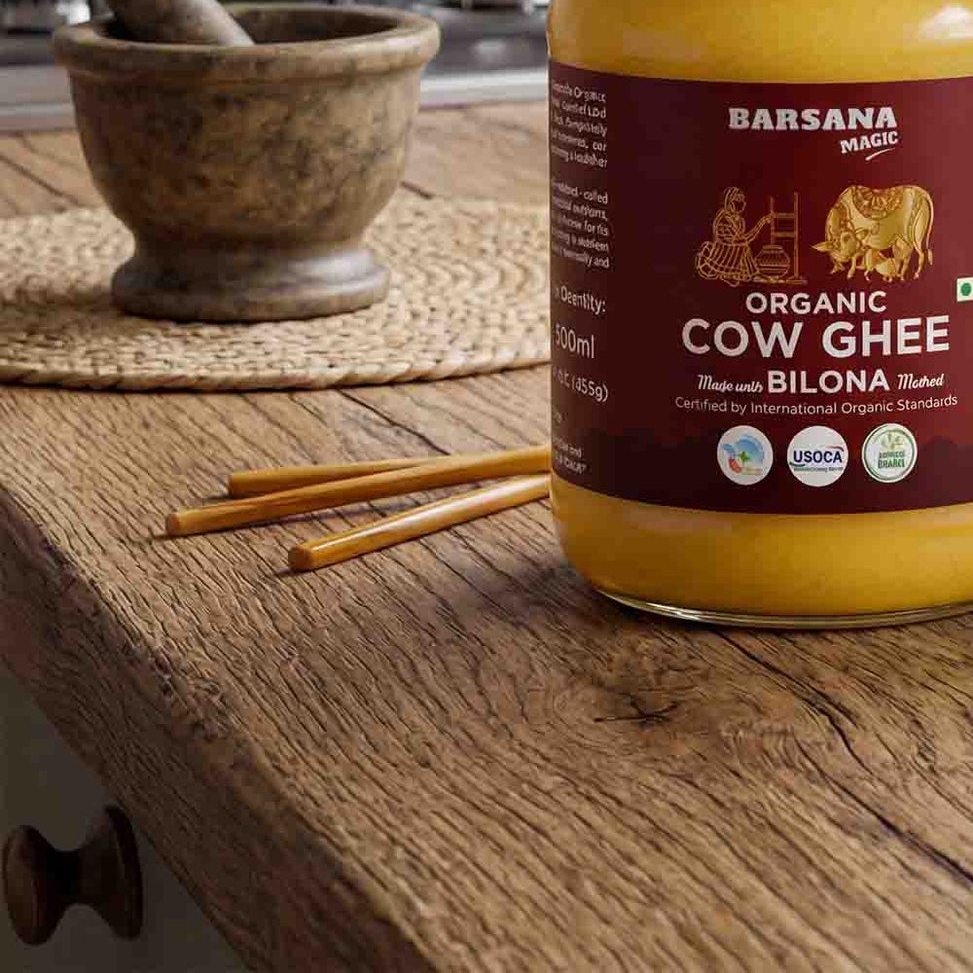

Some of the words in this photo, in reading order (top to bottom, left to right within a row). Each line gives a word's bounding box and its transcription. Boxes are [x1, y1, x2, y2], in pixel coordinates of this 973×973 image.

[728, 106, 898, 131] BARSANA
[840, 131, 899, 154] MAGIC
[745, 290, 887, 315] ORGANIC
[681, 318, 804, 358] COW
[821, 315, 950, 358] GHEE
[767, 369, 890, 395] BILONA
[675, 396, 727, 413] Certified
[731, 401, 747, 416] by
[751, 401, 837, 415] International
[841, 400, 894, 415] Organic
[897, 394, 958, 411] Standards
[793, 450, 843, 463] USOCA
